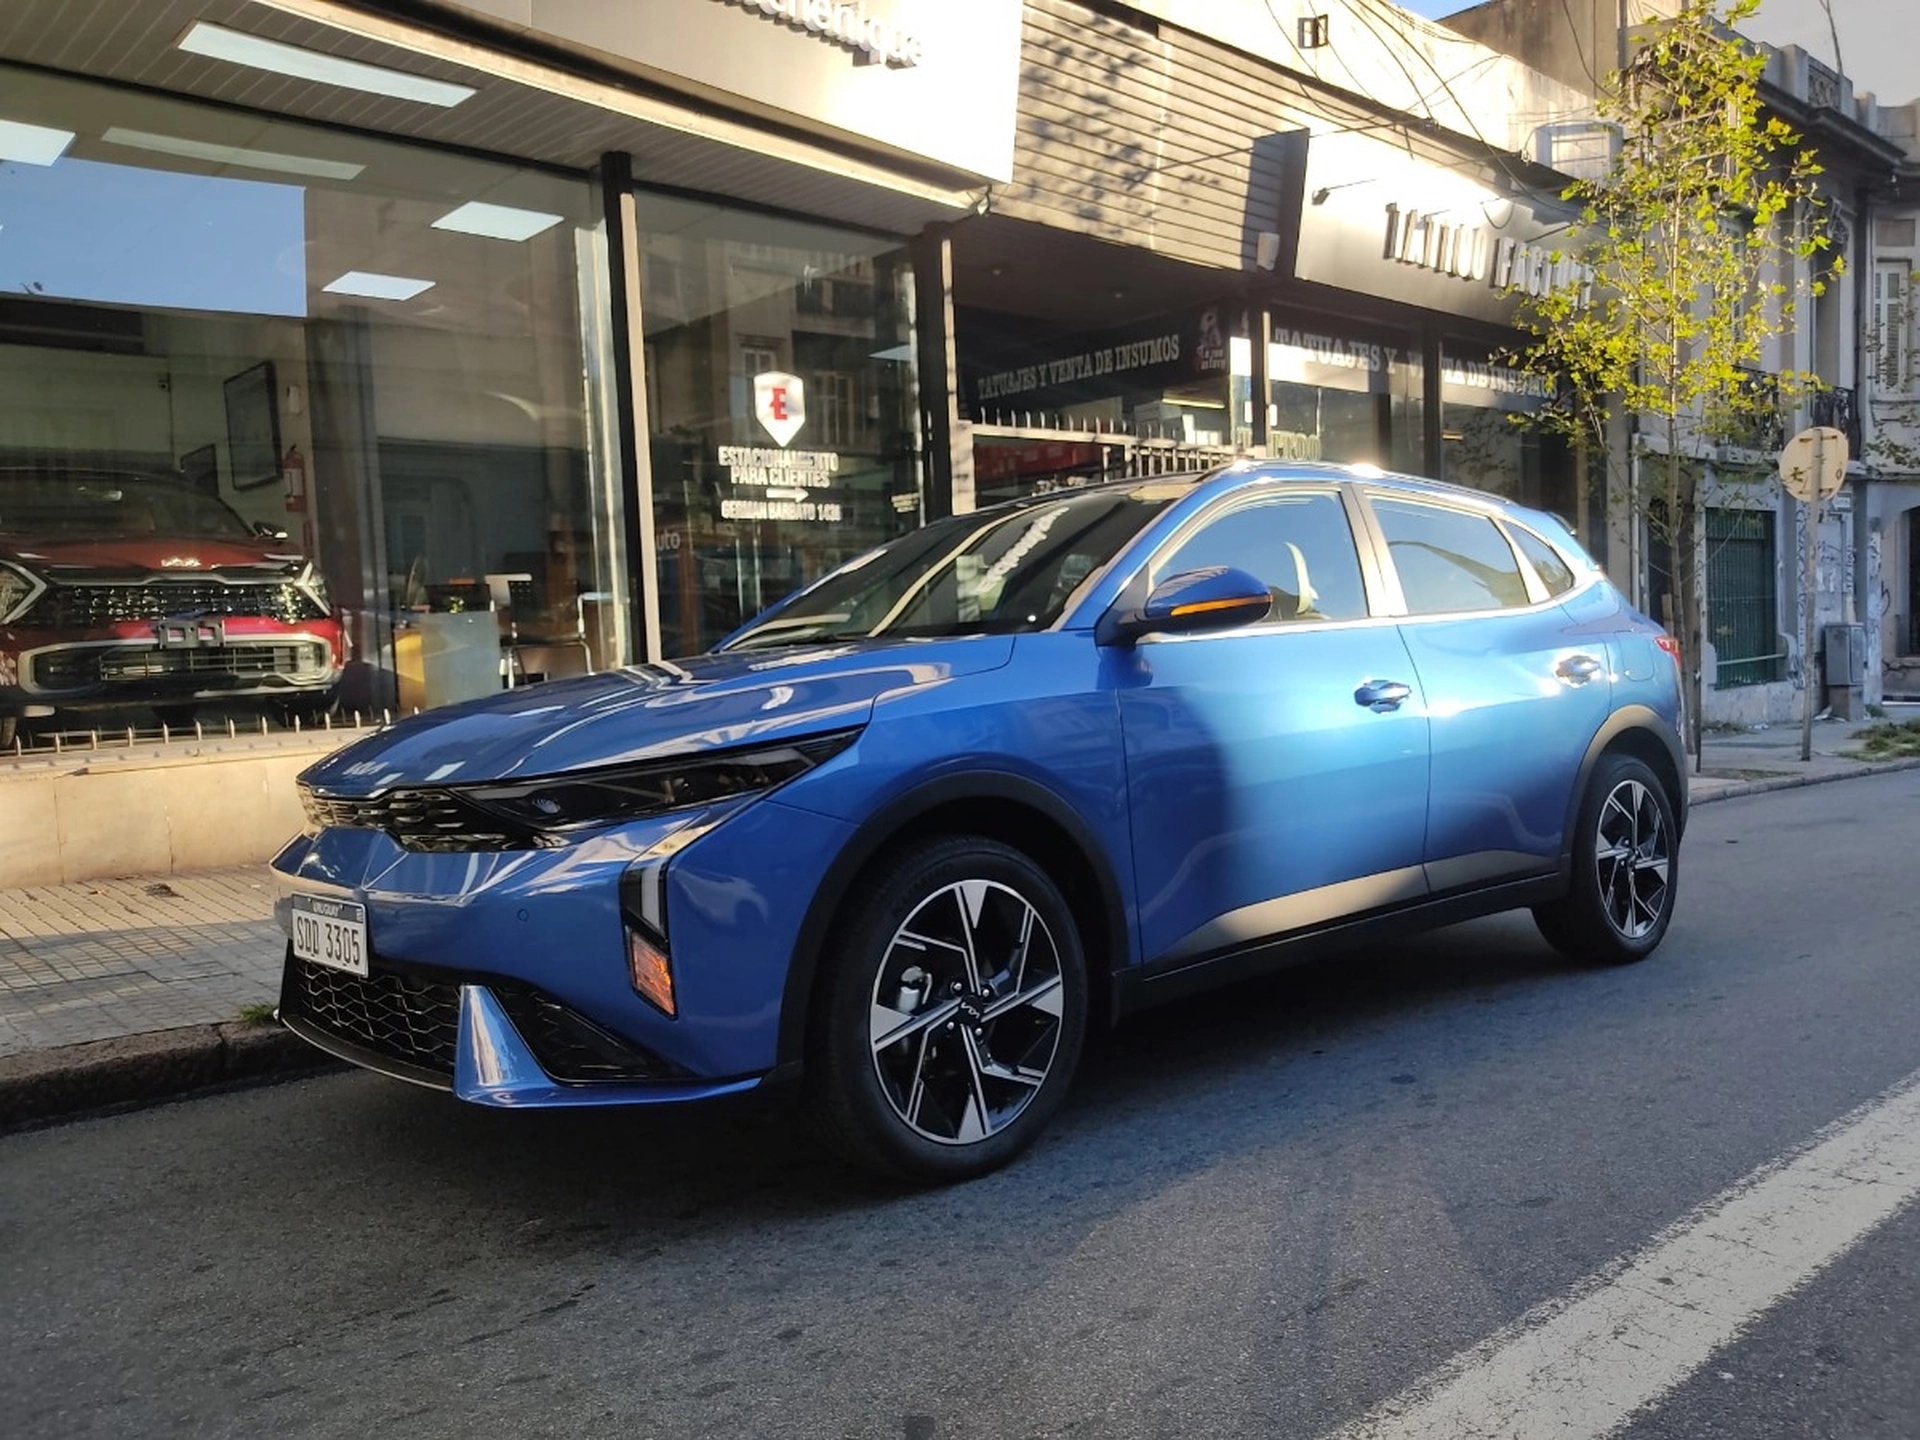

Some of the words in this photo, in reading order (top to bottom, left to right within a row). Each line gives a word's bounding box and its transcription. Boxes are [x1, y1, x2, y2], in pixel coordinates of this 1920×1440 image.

[977, 365, 1037, 400] TATUAJES
[1037, 364, 1048, 388] Y
[1048, 353, 1093, 385] VENTA
[1094, 348, 1114, 375] DE
[1115, 334, 1180, 370] INSUMOS
[1274, 327, 1381, 373] TATUAJES
[1384, 347, 1398, 375] Y
[769, 387, 788, 421] E
[731, 466, 768, 486] PARA
[769, 467, 831, 488] CLIENTES
[655, 528, 681, 551] uto
[296, 915, 320, 955] SDD
[325, 922, 360, 966] 3305
